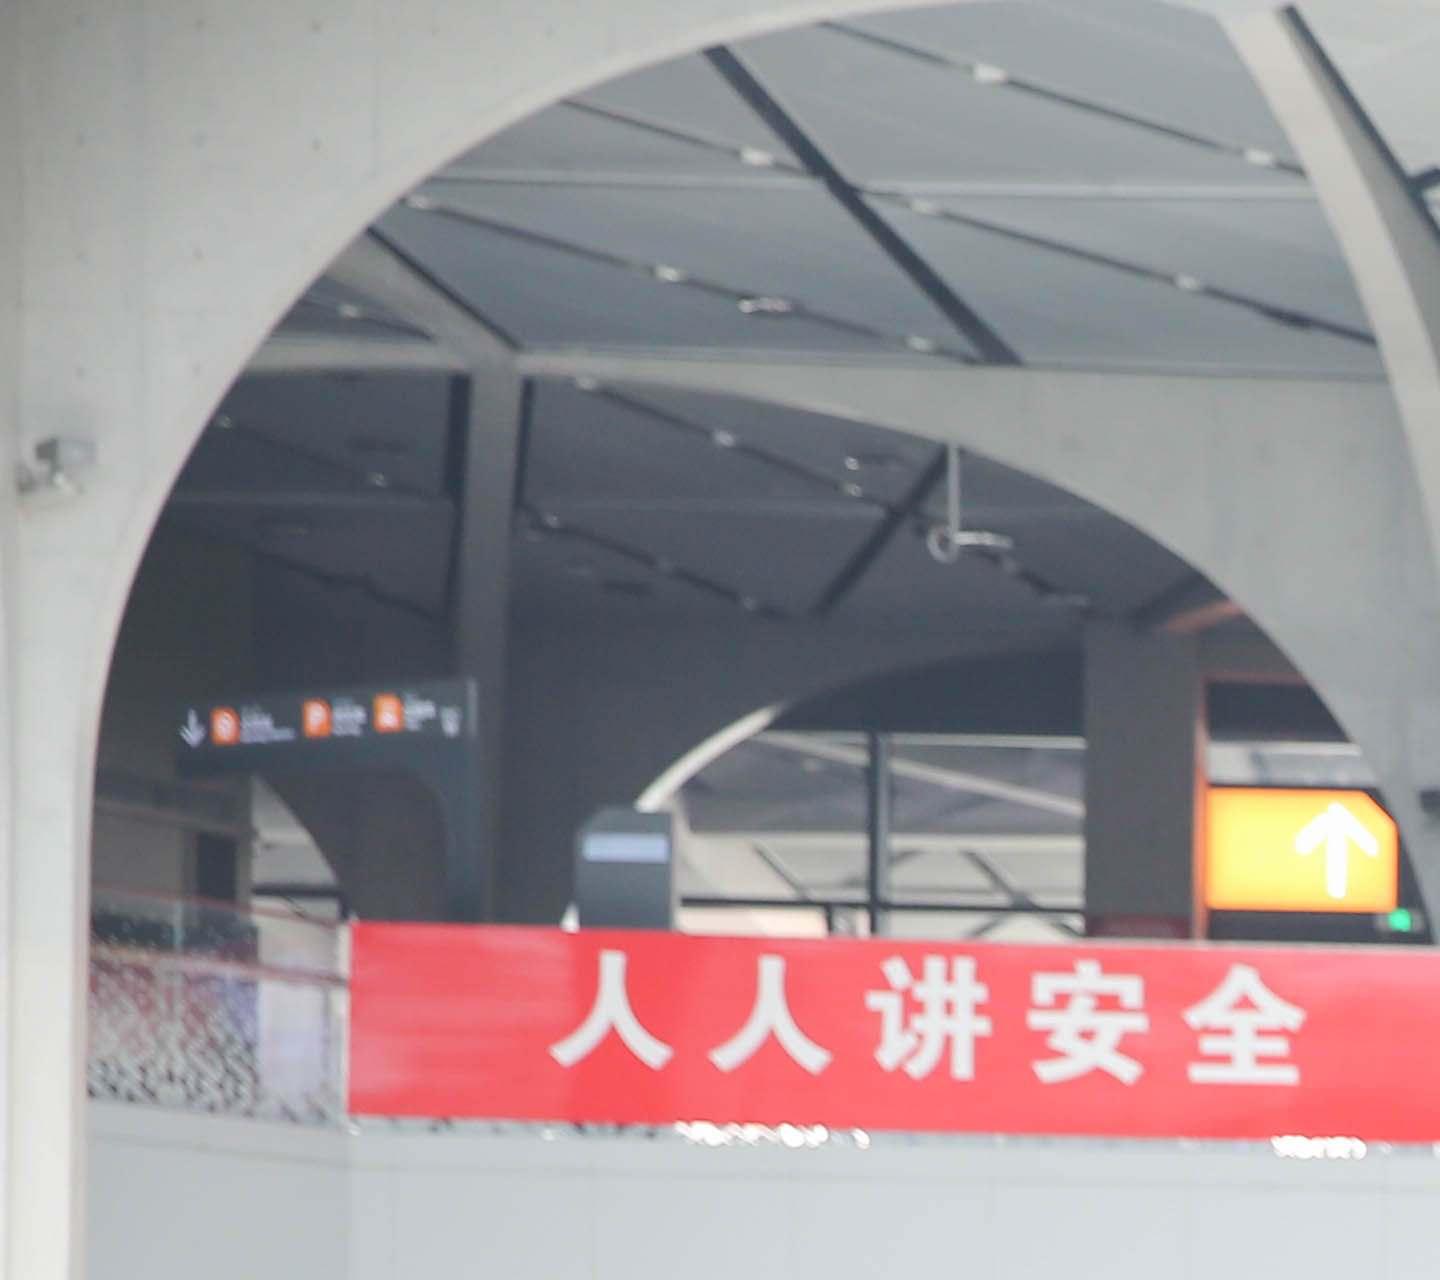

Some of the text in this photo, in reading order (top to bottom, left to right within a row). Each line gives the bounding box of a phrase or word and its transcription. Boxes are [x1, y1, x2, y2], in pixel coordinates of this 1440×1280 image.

[549, 948, 1307, 1087] 人人讲安全
